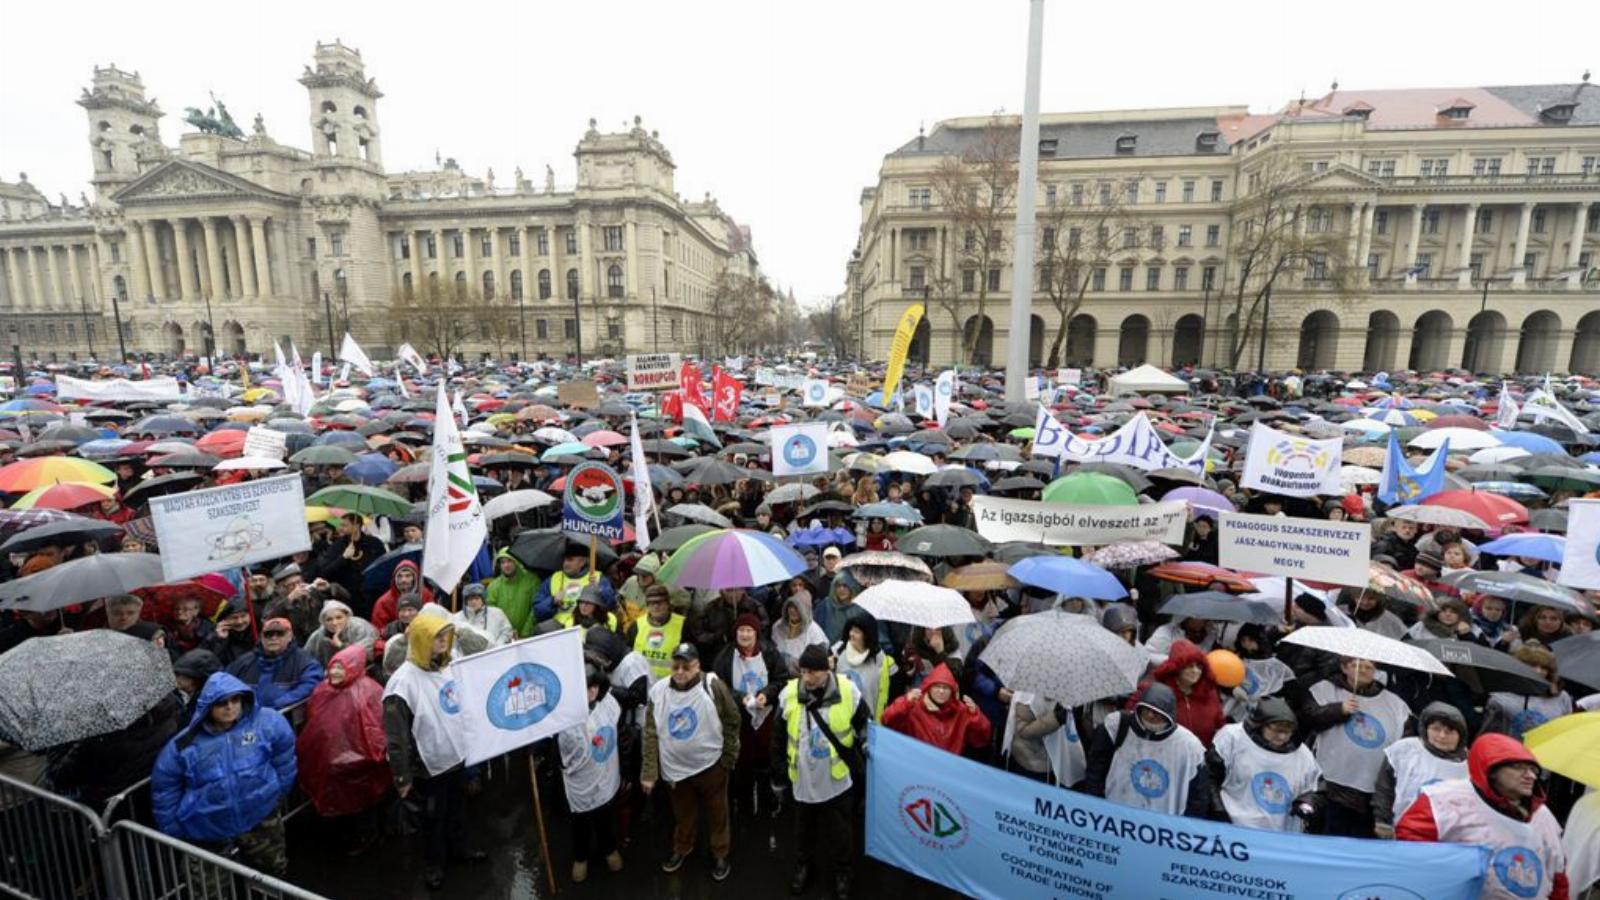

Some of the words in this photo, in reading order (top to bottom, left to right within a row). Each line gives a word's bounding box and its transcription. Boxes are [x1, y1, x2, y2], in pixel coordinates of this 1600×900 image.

[633, 369, 677, 385] KORRUPCIÓ
[207, 499, 260, 519] SZAKSZERVEZET
[981, 507, 997, 521] Az
[1078, 515, 1140, 529] elveszett
[1143, 516, 1159, 527] az
[562, 518, 623, 539] HUNGARY
[1281, 524, 1362, 541] SZAKSZERVEZET
[1234, 535, 1350, 558] JÁSZ-NAGYKUN-SZOLNOK
[1273, 556, 1306, 569] MEGYE
[995, 811, 1121, 856] SZAKSZERVEZETEK
[1034, 797, 1250, 862] MAGYARORSZÁG
[998, 823, 1118, 867] EGYÜTTMŰKÖDÉSI
[1029, 843, 1085, 869] FÓRUMA
[1001, 852, 1093, 888] COOPERATION
[1095, 881, 1114, 894] OF
[1010, 866, 1051, 886] TRADE
[1054, 880, 1104, 900] UNIONS
[1161, 871, 1296, 900] SZAKSZERVEZETE
[1170, 862, 1288, 891] PEDAGÓGUSOK
